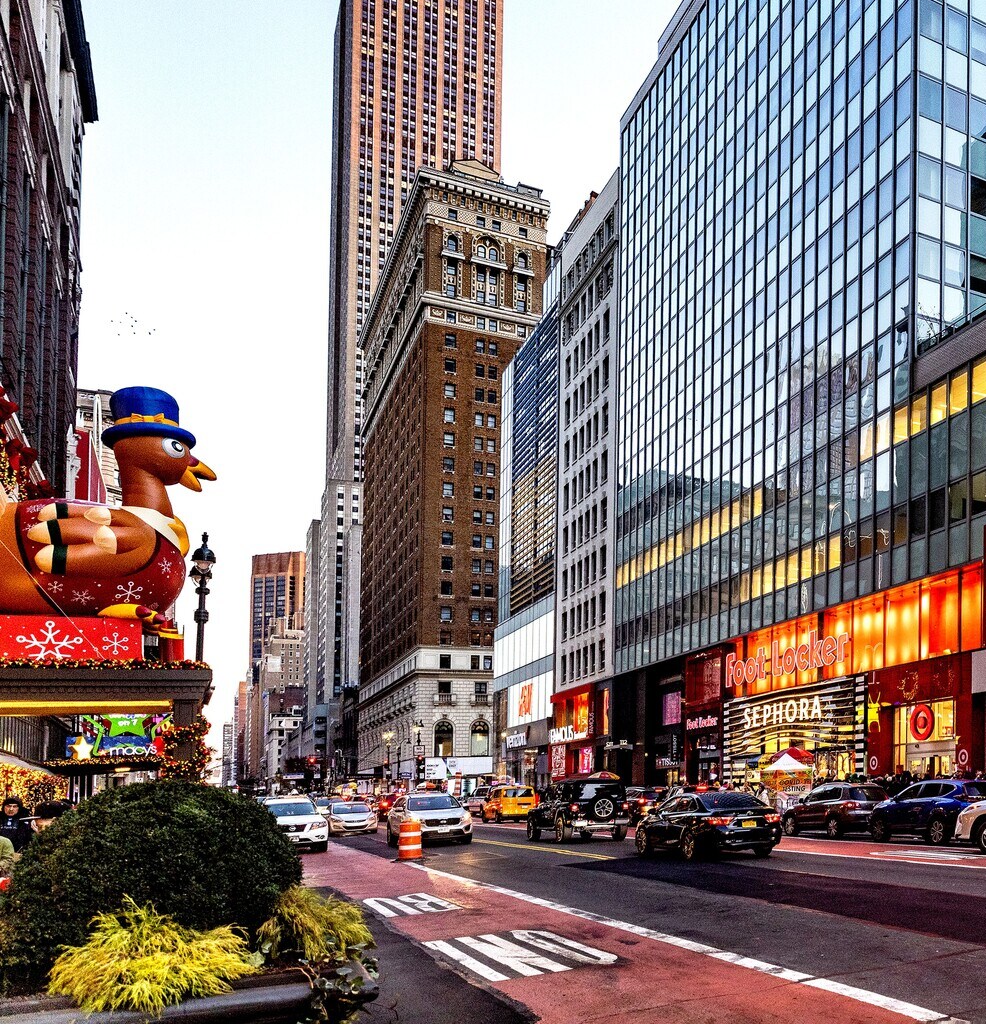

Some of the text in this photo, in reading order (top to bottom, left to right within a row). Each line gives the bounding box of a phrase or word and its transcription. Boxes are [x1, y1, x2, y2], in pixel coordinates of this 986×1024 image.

[725, 627, 849, 688] Foot Locker
[744, 695, 822, 730] SEPHORA
[506, 730, 528, 749] verizon
